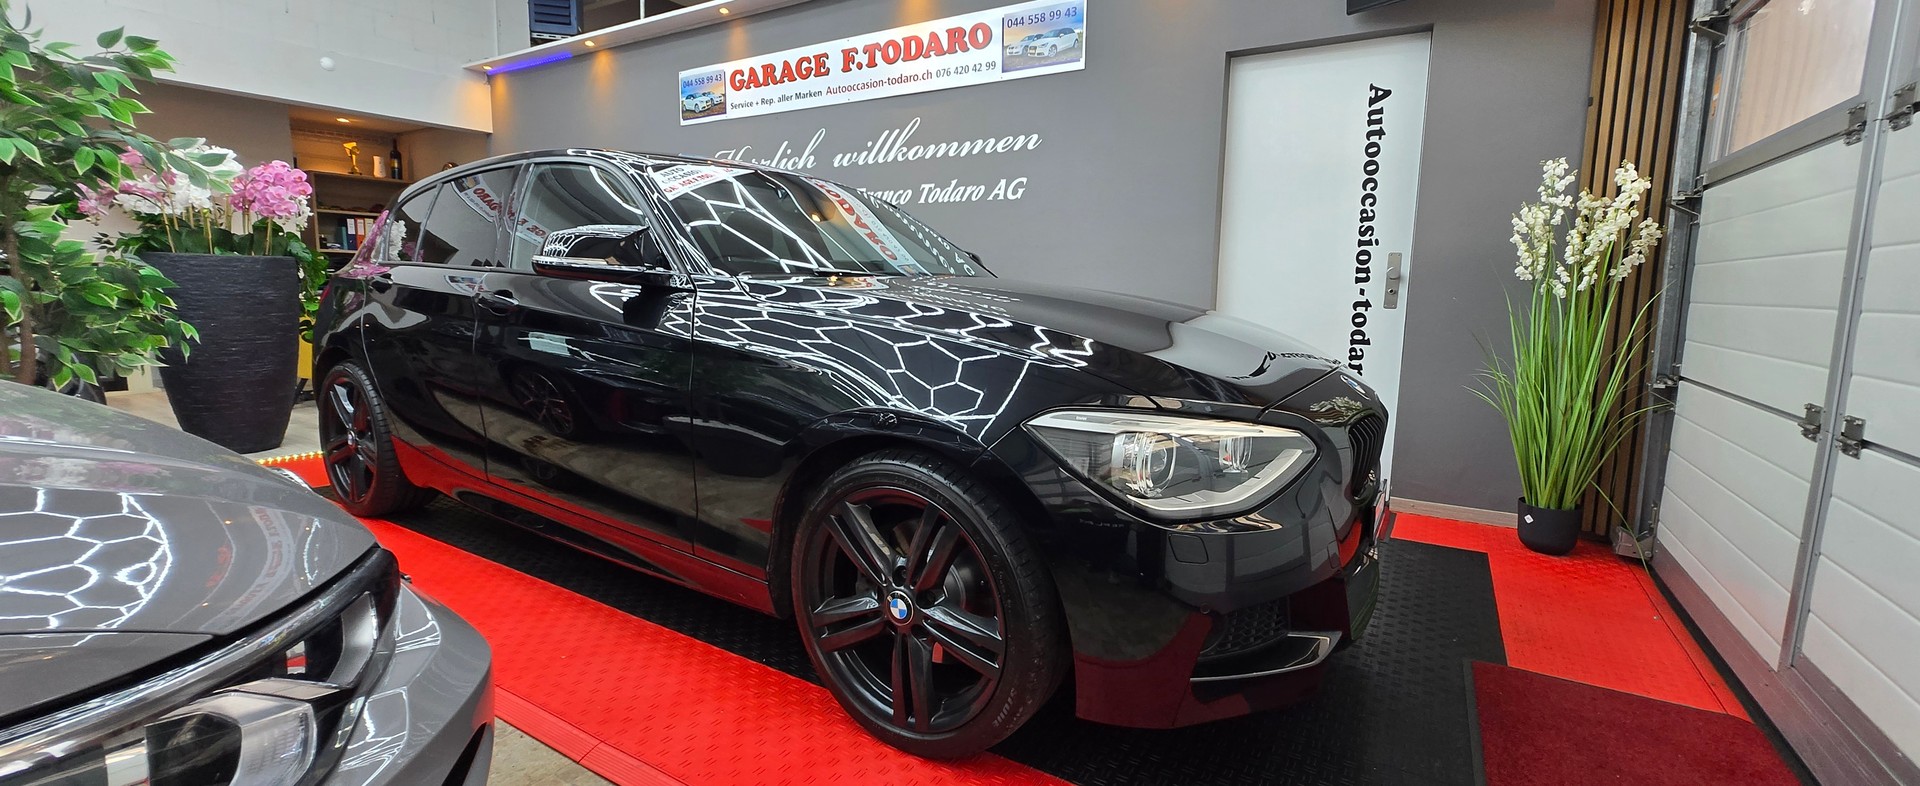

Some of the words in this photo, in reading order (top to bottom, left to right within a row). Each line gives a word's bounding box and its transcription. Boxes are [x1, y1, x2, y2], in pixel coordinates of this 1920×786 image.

[1006, 16, 1025, 28] 044
[1028, 12, 1046, 25] 558
[1049, 9, 1062, 21] 99
[1064, 6, 1078, 18] 43
[729, 52, 831, 92] GARAGE
[841, 22, 993, 73] F.TODARO
[682, 79, 694, 89] 044
[694, 76, 705, 86] 558
[706, 75, 714, 84] 99
[714, 73, 723, 82] 43
[730, 100, 754, 110] Service
[760, 97, 776, 107] Rep.
[777, 94, 793, 103] aller
[794, 89, 823, 100] Marken
[825, 69, 933, 96] Autooccasion-todaro.ch
[935, 67, 951, 78] 076
[953, 64, 970, 75] 420
[972, 62, 983, 73] 42
[985, 60, 997, 71] 99
[833, 117, 1043, 169] willkommen
[918, 179, 986, 204] Todaro
[987, 177, 1027, 201] AG
